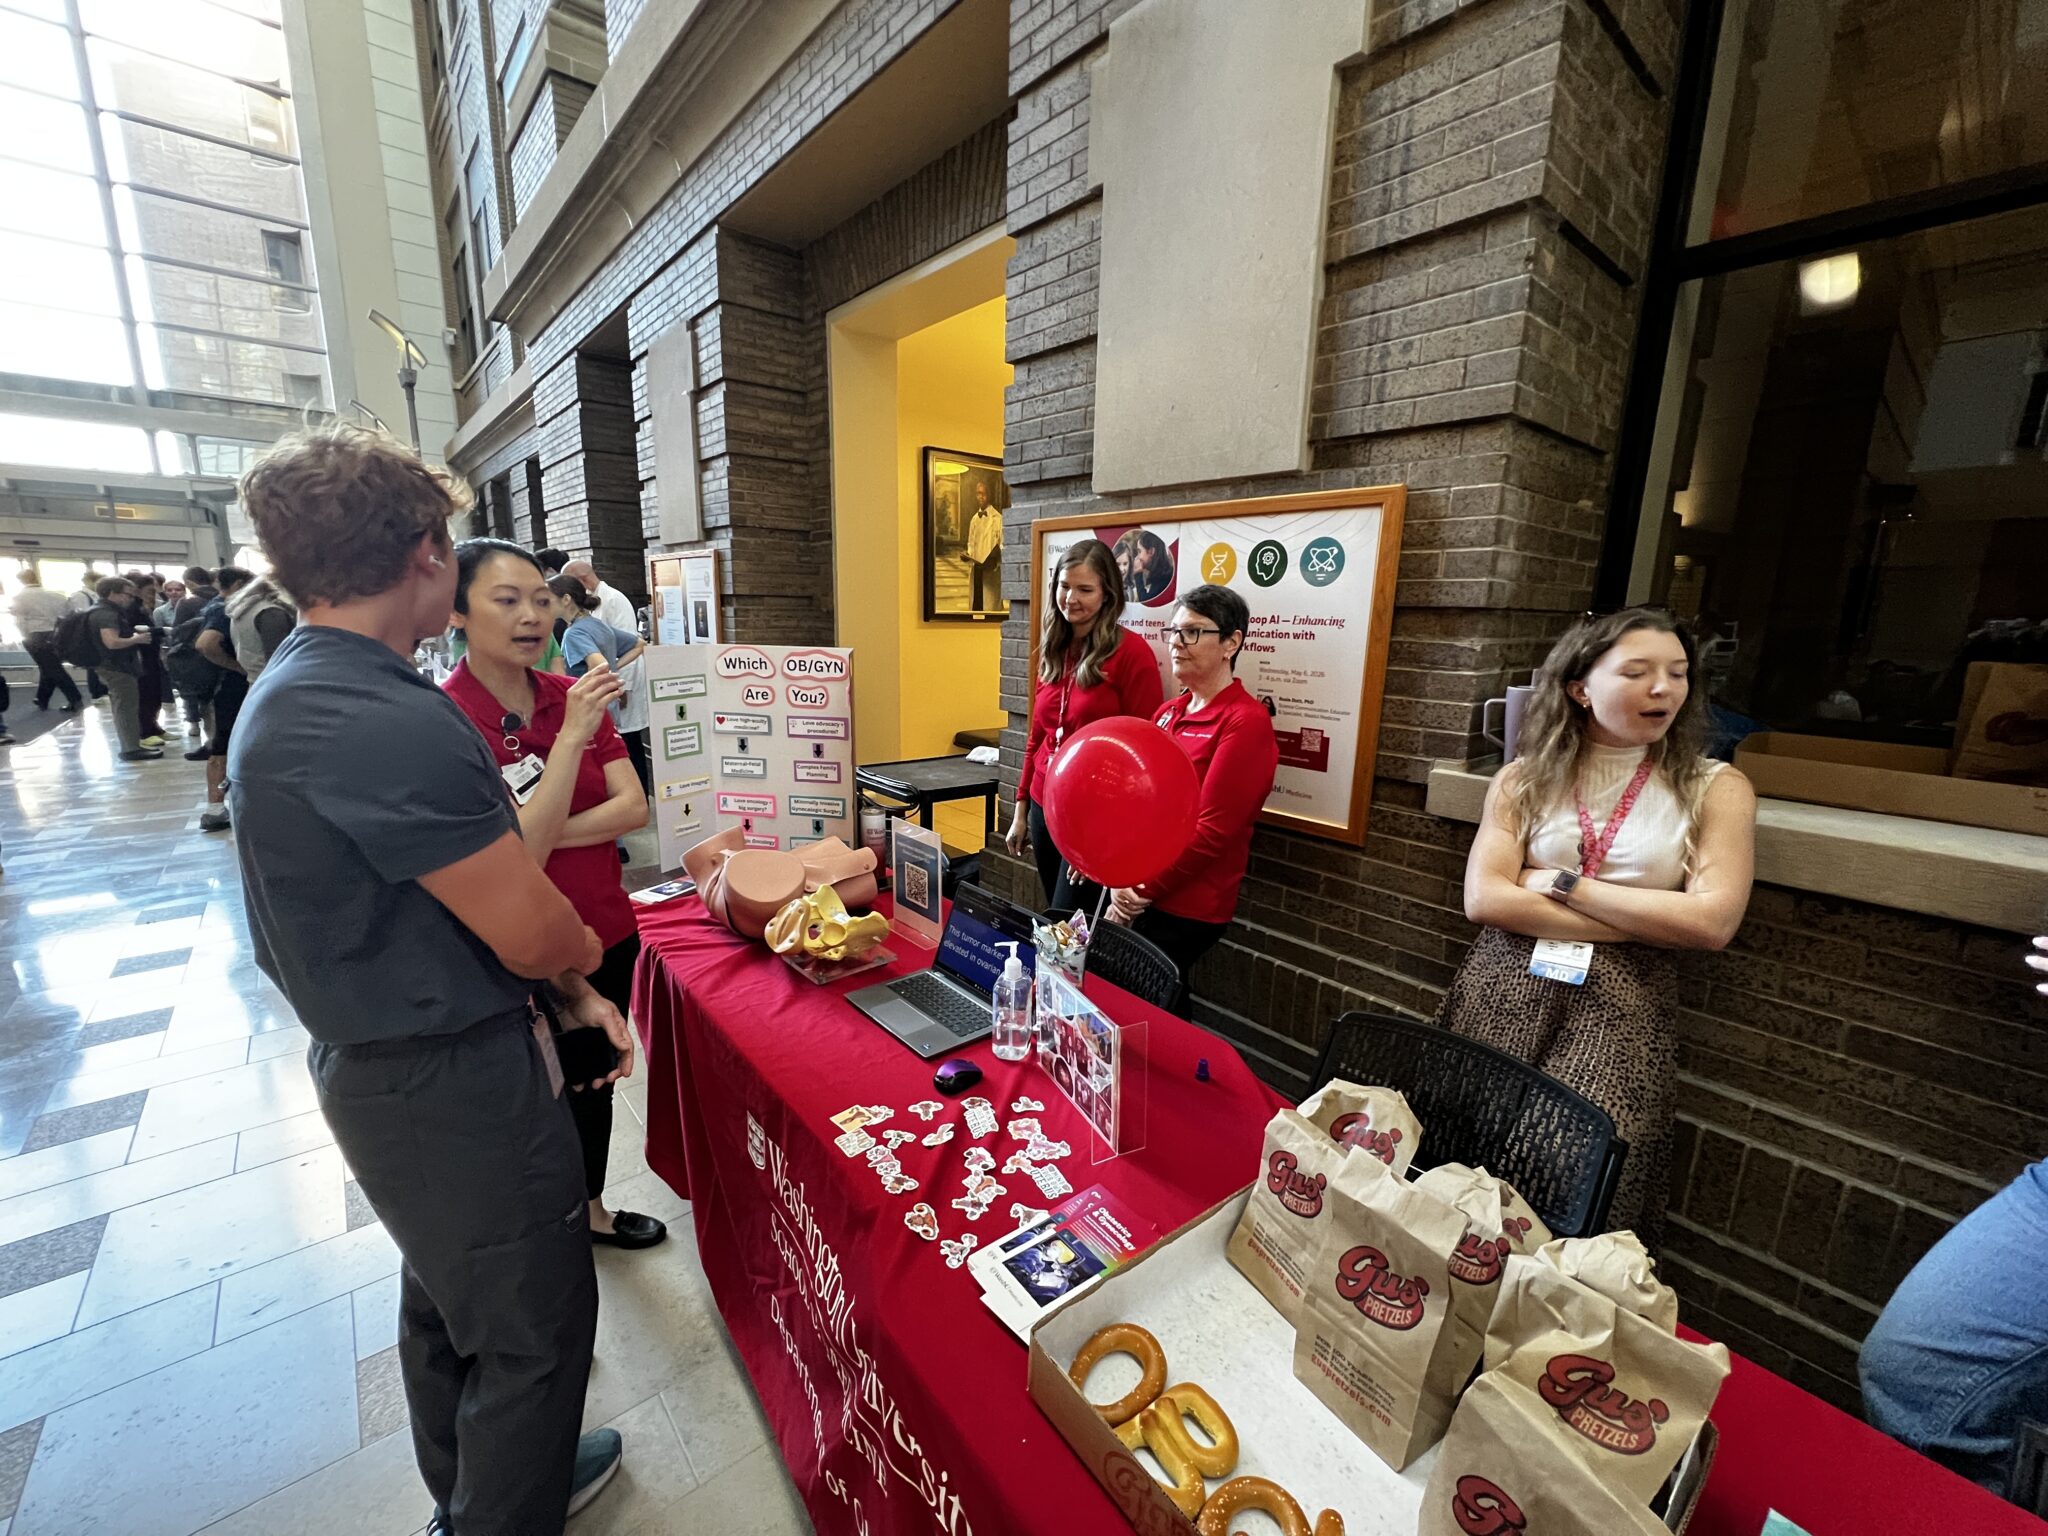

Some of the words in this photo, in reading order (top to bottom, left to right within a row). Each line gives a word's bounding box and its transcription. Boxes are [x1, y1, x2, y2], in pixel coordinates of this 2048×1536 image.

[1248, 616, 1267, 626] oop
[1269, 615, 1280, 624] AI
[1292, 615, 1346, 629] Enhancing
[1293, 630, 1316, 640] with
[724, 657, 768, 670] Which
[786, 660, 844, 674] OB/GYN
[745, 688, 769, 700] Are
[792, 690, 825, 704] You?
[1286, 789, 1312, 800] Medicine
[944, 940, 970, 958] elevated
[970, 952, 976, 961] in
[976, 958, 1001, 976] ovarian
[948, 924, 960, 937] This
[961, 932, 980, 948] tumor
[981, 942, 1005, 960] marker
[1546, 968, 1568, 980] MD
[1267, 1150, 1327, 1200] Gus'
[1283, 1191, 1316, 1214] PRETZELS
[1098, 1207, 1132, 1238] Obstetrics
[1098, 1216, 1136, 1250] Gynecology
[766, 1137, 845, 1346] Washington
[1248, 1238, 1300, 1297] guspretzels.com
[1336, 1246, 1430, 1306] Gus'
[1450, 1258, 1488, 1280] RETZELS
[1364, 1295, 1412, 1324] PRETZELS
[772, 1294, 826, 1477] Department
[1312, 1353, 1392, 1427] guspretzels.com
[1538, 1354, 1670, 1434] Gus'
[1570, 1406, 1640, 1450] PRETZELS
